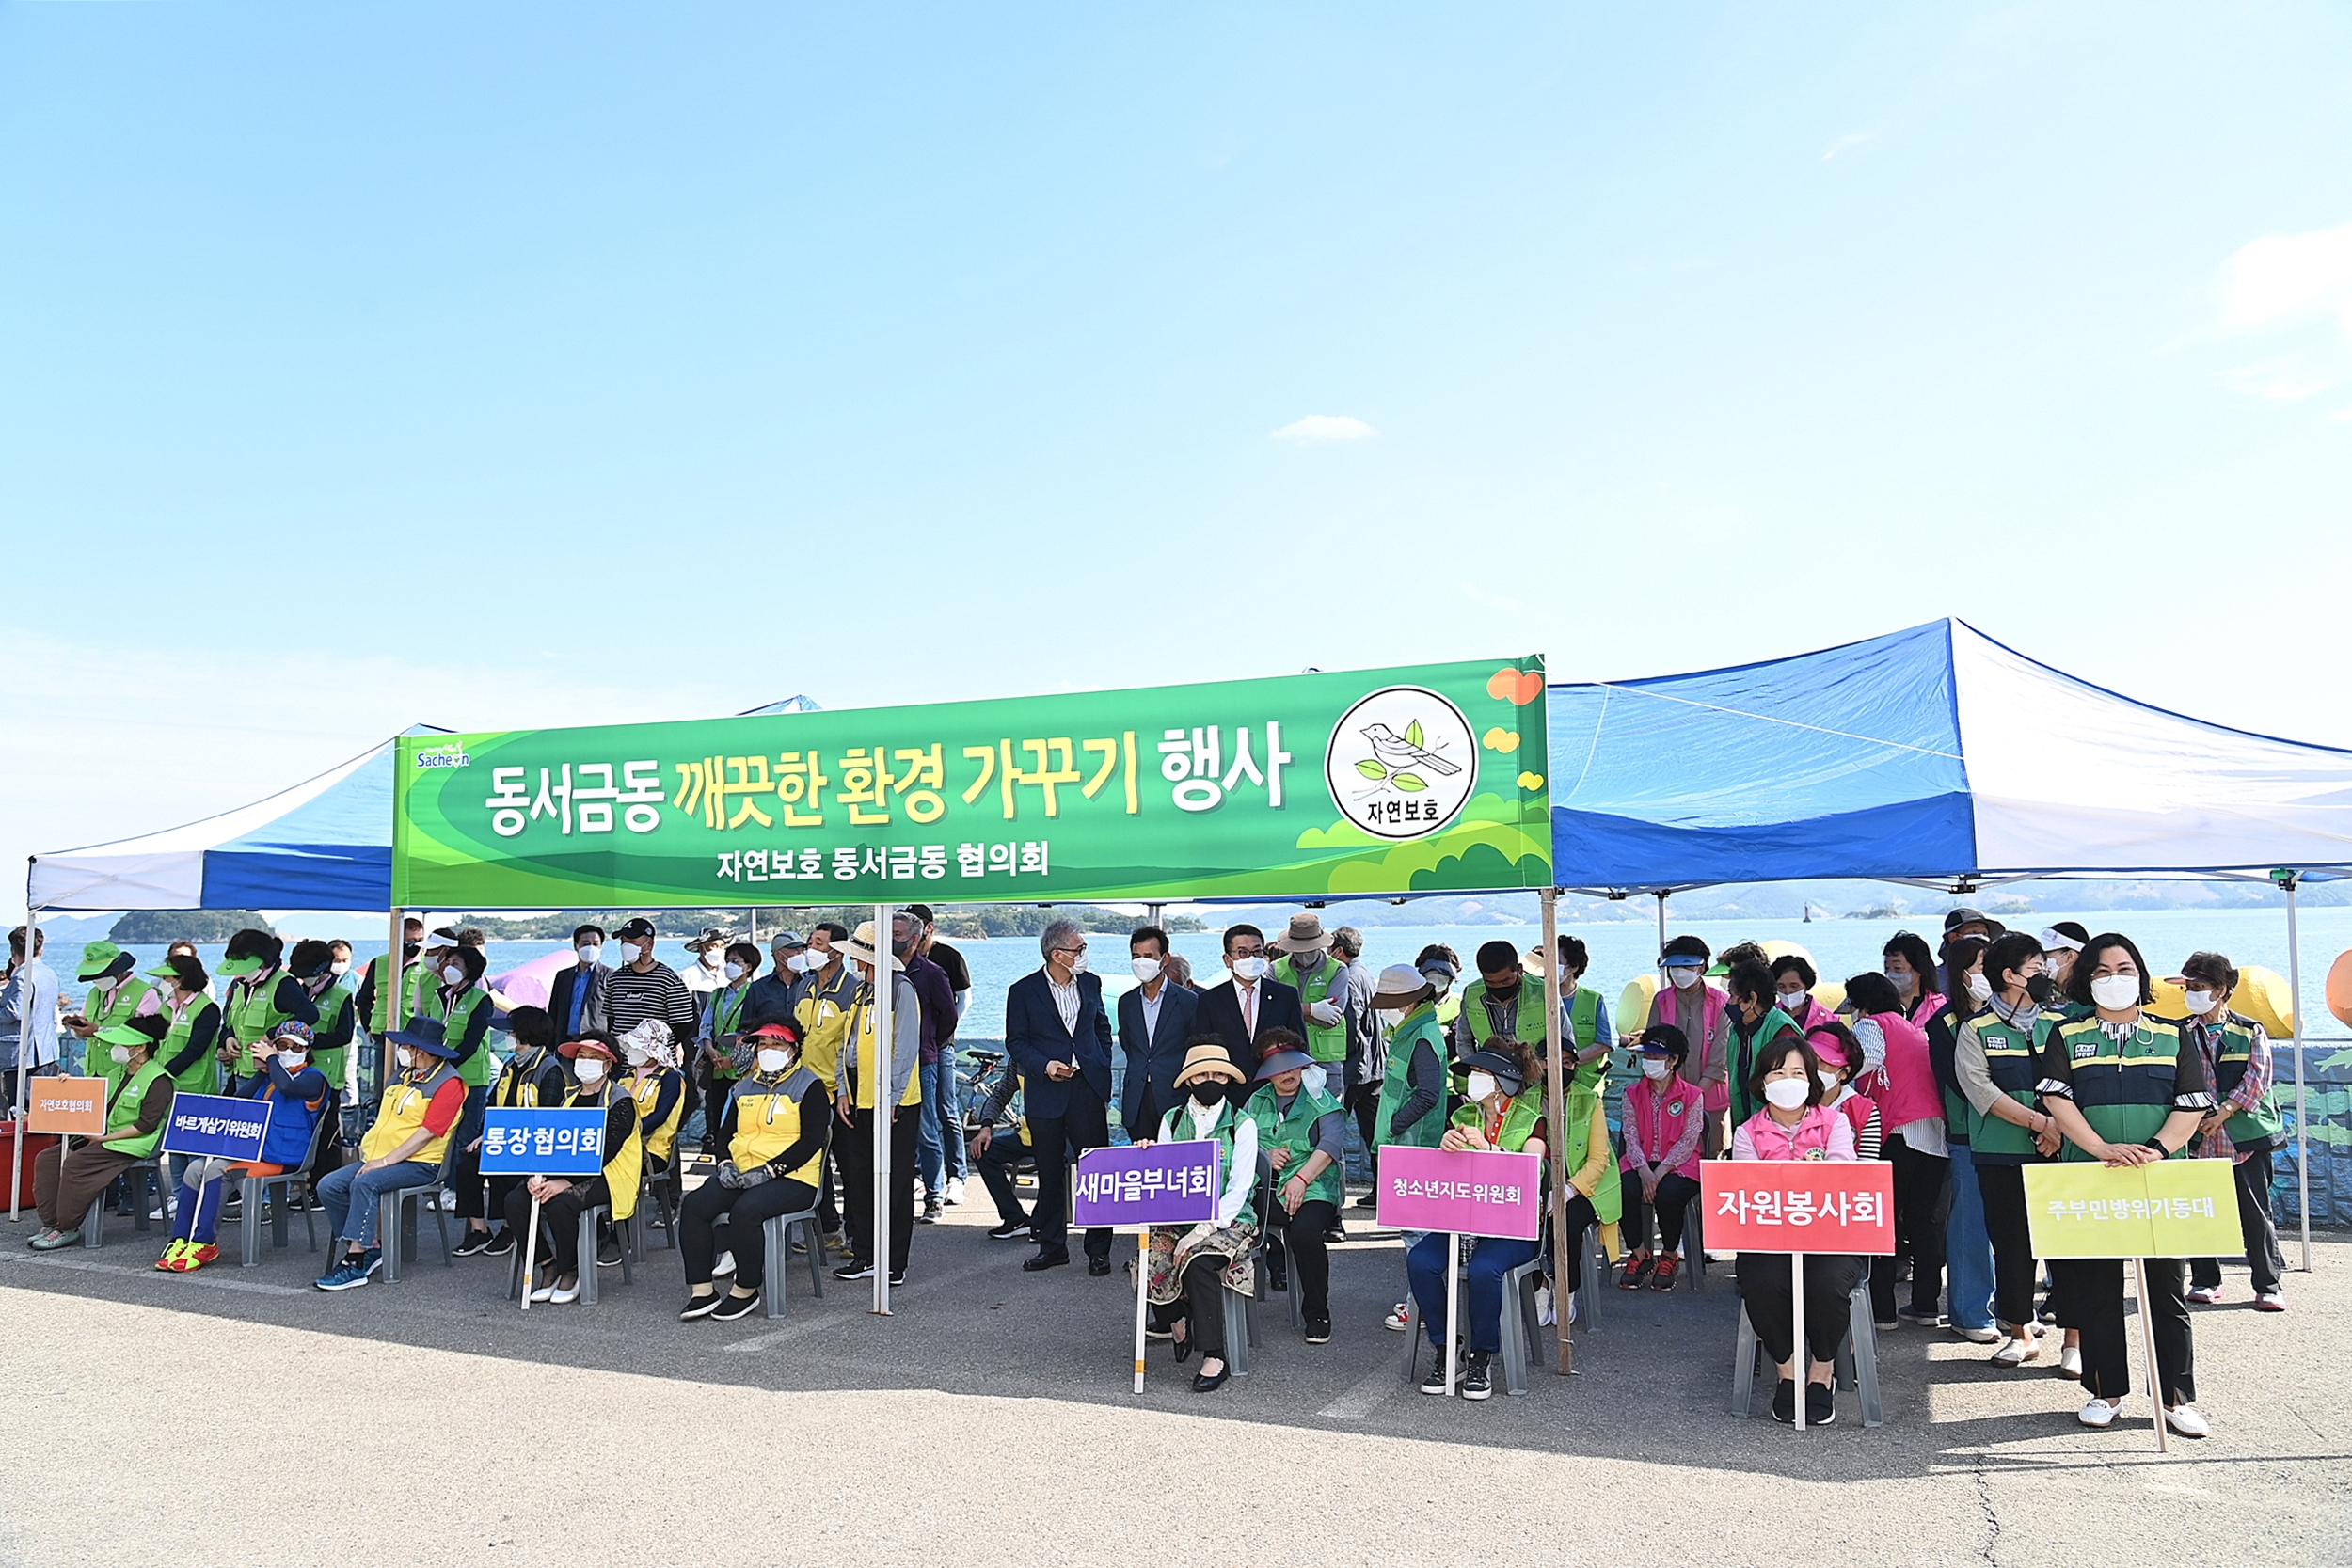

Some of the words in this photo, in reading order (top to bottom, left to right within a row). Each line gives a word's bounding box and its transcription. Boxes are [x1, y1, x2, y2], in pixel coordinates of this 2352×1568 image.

[485, 759, 665, 837] 동서금동
[673, 750, 828, 831] 깨끗한
[836, 742, 946, 825] 환경
[961, 730, 1138, 820] 가꾸기
[1157, 720, 1292, 812] 행사
[1367, 798, 1439, 825] 자연보호
[716, 847, 824, 883] 자연보호
[831, 845, 948, 881] 동서금동
[956, 840, 1049, 879] 협의회
[40, 1098, 93, 1114] 자연보호협의회
[174, 1114, 263, 1141] 바르게살기위원회
[1075, 1164, 1213, 1204] 새마을부녀회
[1392, 1177, 1521, 1206] 청소년지도위원회
[1716, 1189, 1883, 1227] 자원봉사회
[2046, 1196, 2216, 1222] 주부민방위기동대
